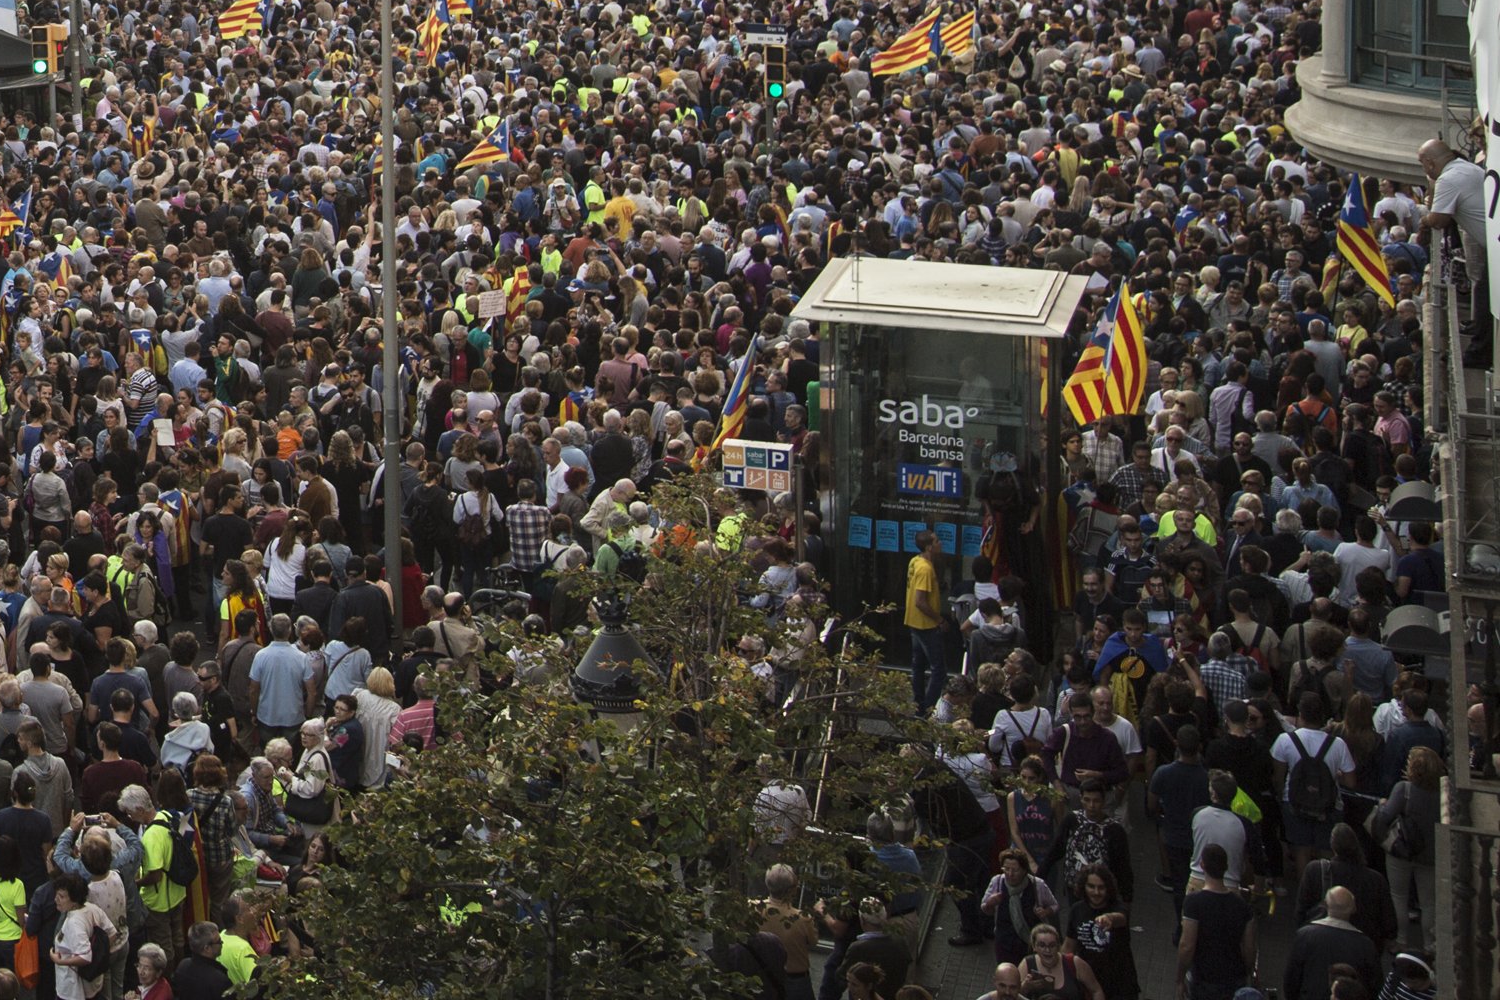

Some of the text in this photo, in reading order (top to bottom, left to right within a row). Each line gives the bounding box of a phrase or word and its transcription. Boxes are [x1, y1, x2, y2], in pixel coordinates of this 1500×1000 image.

[879, 394, 964, 429] saba
[899, 429, 964, 447] Barcelona
[772, 451, 785, 467] P
[920, 445, 964, 461] bamsa
